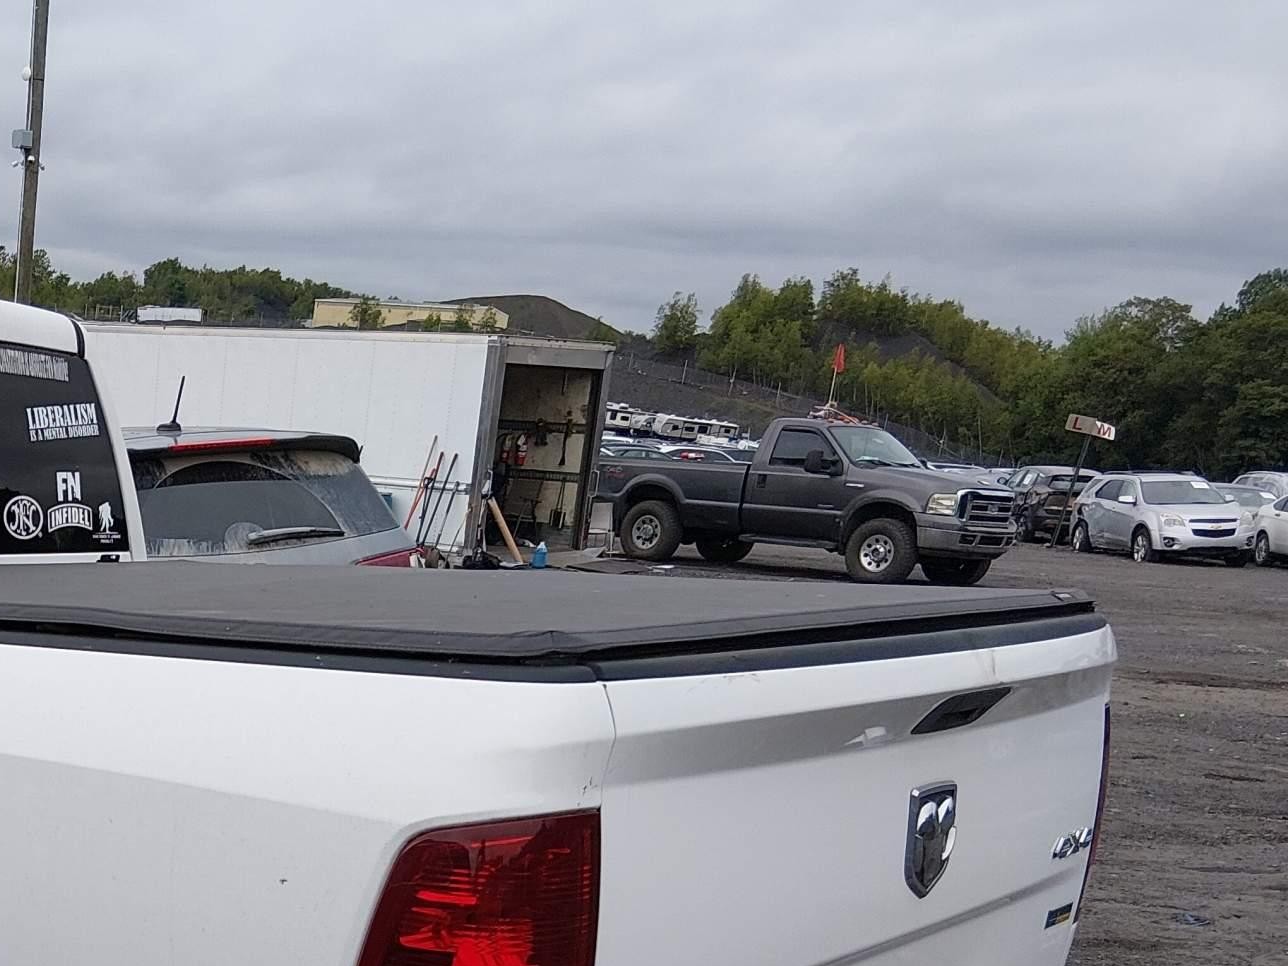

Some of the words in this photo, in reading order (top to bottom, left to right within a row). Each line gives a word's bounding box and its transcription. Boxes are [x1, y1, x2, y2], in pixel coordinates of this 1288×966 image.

[26, 402, 98, 430] LIBERALISM
[29, 430, 37, 442] IS
[37, 429, 43, 441] A
[43, 427, 68, 441] MENTAL
[68, 424, 100, 438] DISORDER
[56, 471, 82, 502] FN
[51, 506, 90, 528] INFIDEL
